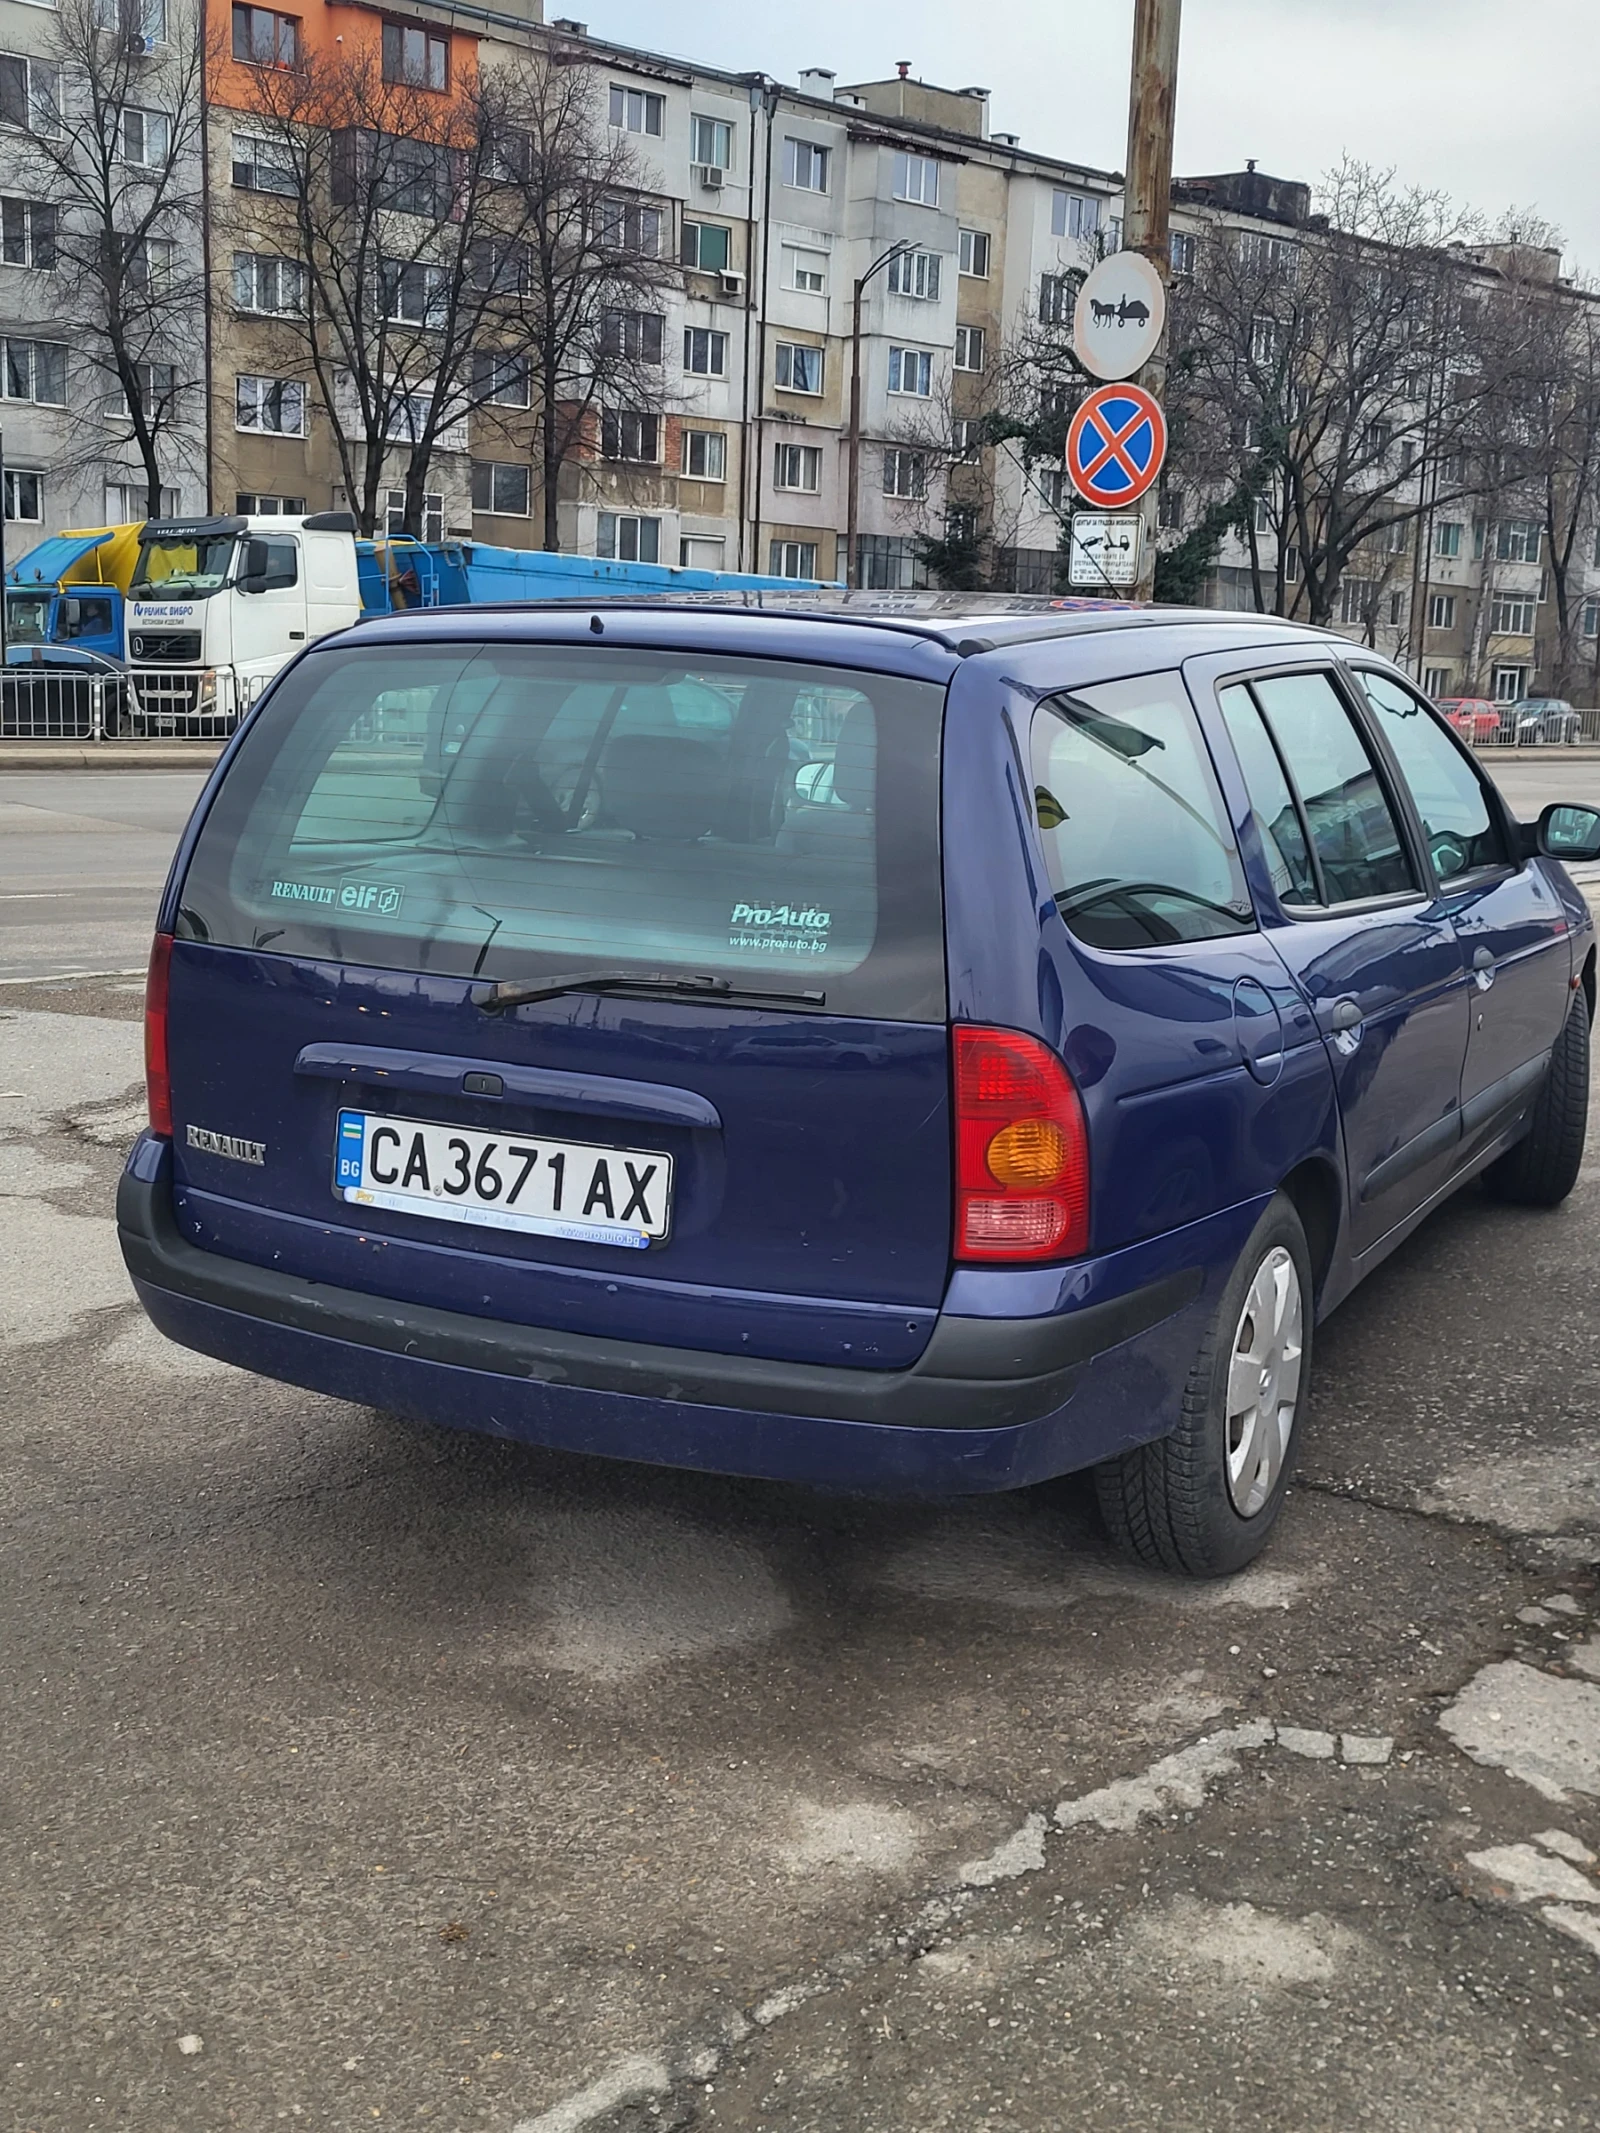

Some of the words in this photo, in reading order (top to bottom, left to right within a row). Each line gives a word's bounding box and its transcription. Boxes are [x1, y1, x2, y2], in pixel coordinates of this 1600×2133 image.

[169, 605, 193, 616] ВИБРО
[271, 881, 336, 904] RENAULT
[341, 885, 378, 909] elf
[731, 903, 831, 928] ProAuto
[729, 937, 827, 953] www.proauto.bg
[186, 1124, 266, 1167] RENAULT
[340, 1159, 360, 1178] BG
